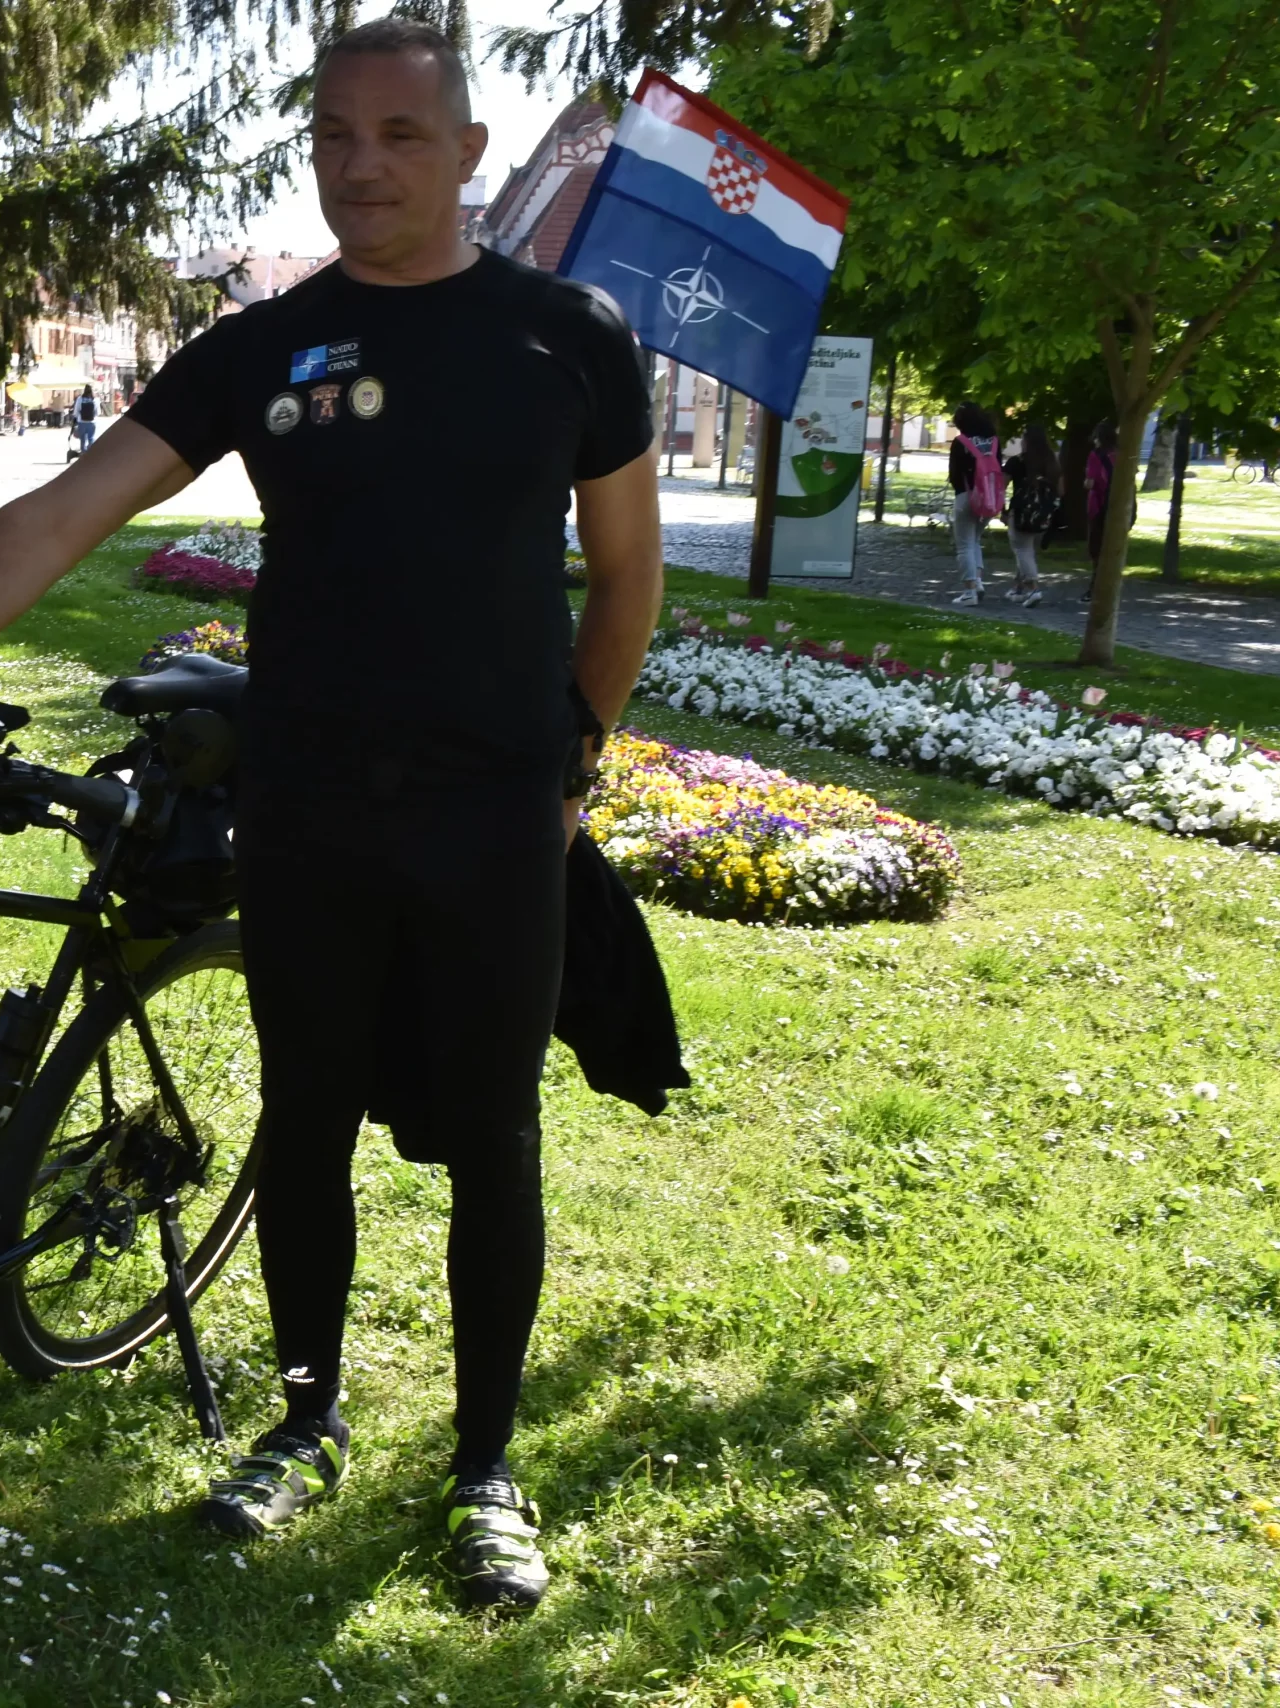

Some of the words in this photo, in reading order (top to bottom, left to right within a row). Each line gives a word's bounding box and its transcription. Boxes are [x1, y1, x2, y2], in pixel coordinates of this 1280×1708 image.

[328, 342, 359, 356] NATO
[811, 347, 861, 361] aditeljska
[327, 358, 359, 372] OTAN
